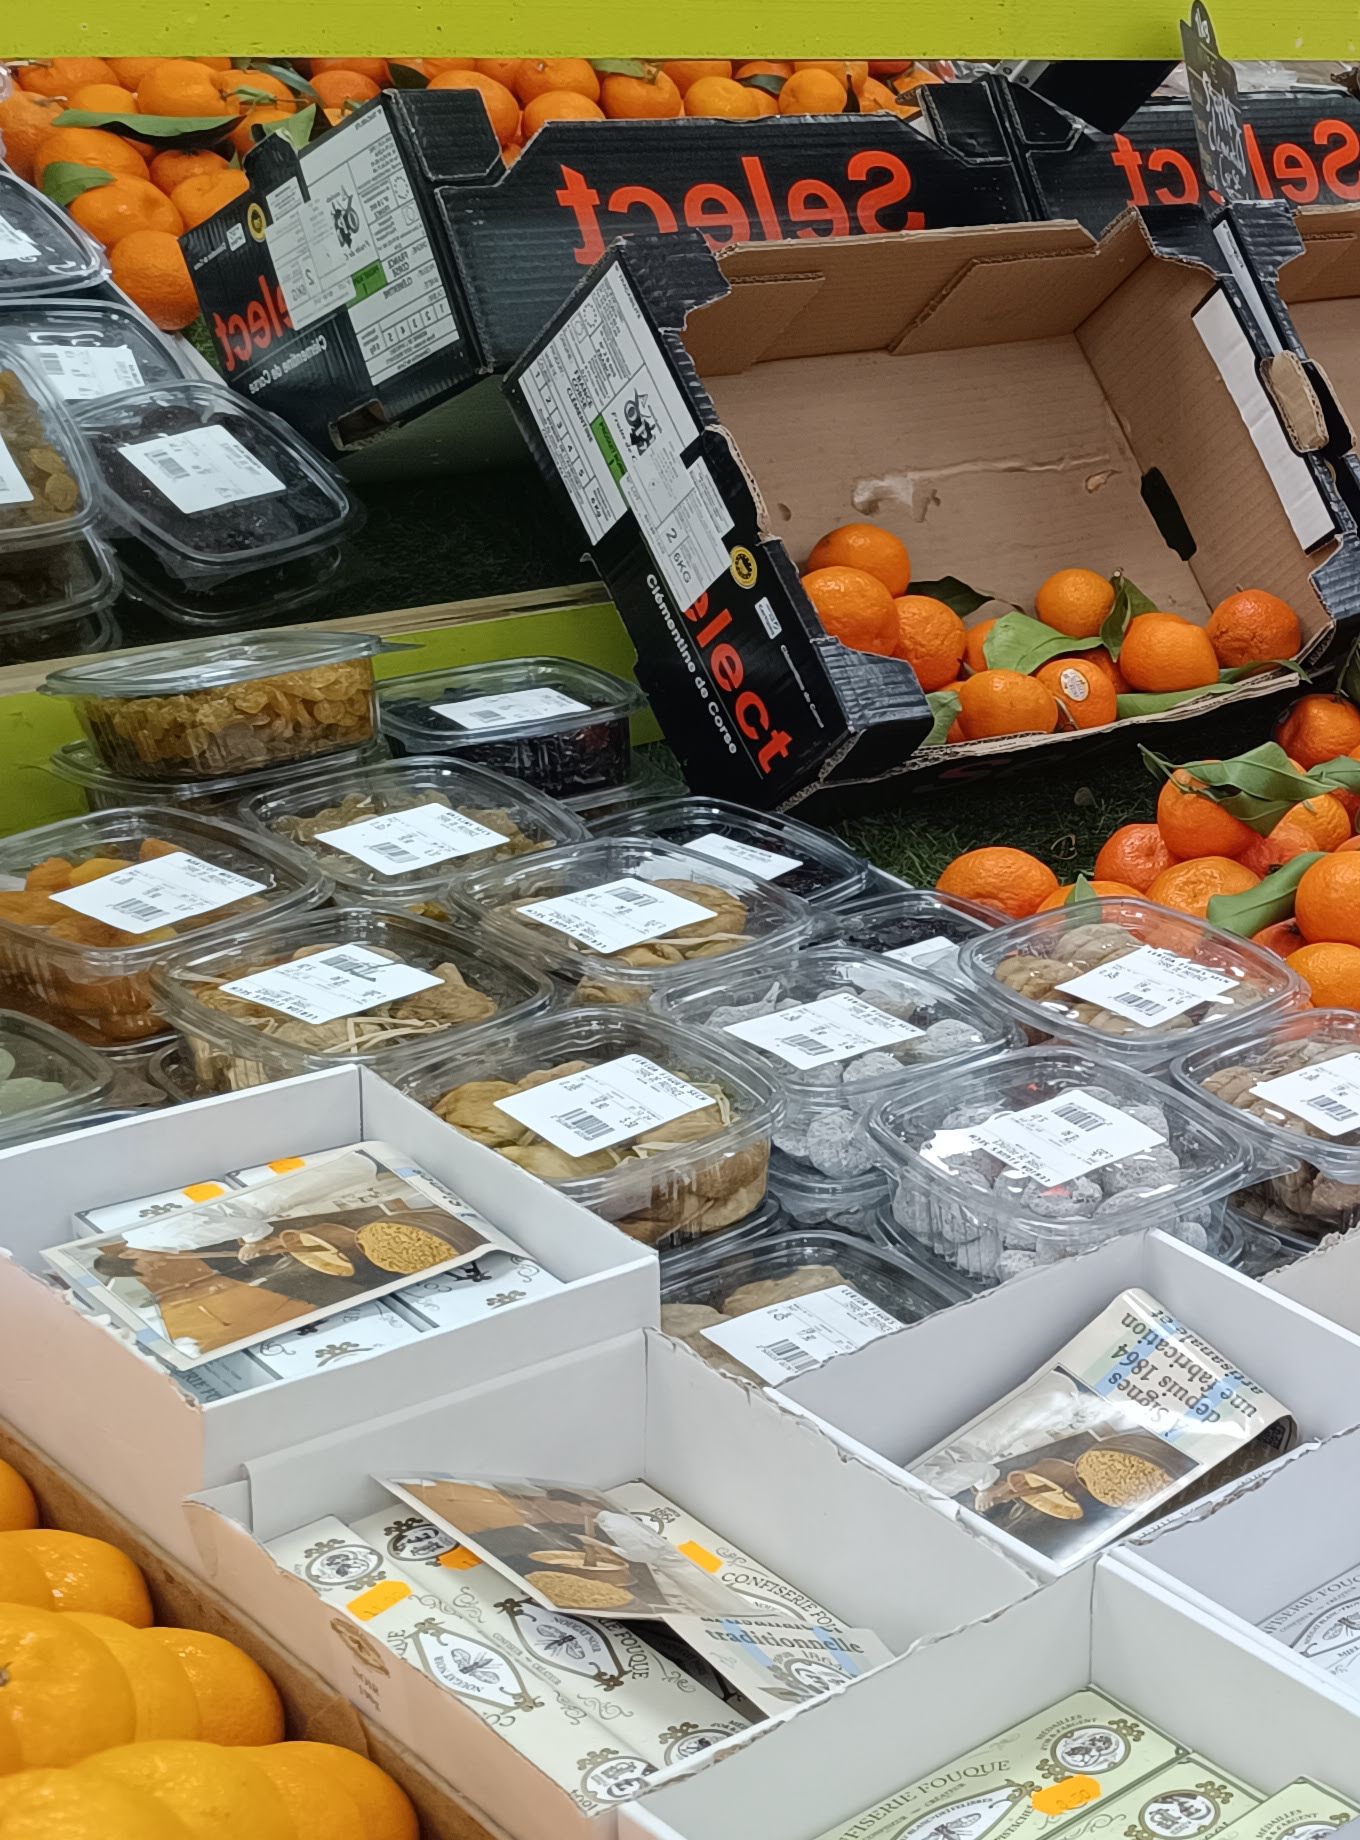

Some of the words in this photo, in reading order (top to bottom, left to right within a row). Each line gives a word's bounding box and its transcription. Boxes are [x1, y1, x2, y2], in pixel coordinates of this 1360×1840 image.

[665, 527, 678, 543] 2
[671, 552, 692, 584] 6KG
[646, 574, 696, 674] Clémentine
[695, 677, 709, 698] de
[708, 700, 737, 754] Corse
[1151, 1310, 1174, 1325] et
[1111, 1343, 1158, 1381] 1864
[1121, 1312, 1220, 1393] fabrication
[1176, 1327, 1264, 1395] artisanale
[1108, 1372, 1169, 1424] Signes
[1158, 1375, 1221, 1424] depuis
[1220, 1386, 1258, 1418] une
[721, 1571, 815, 1617] CONFISERIE
[615, 1629, 650, 1680] FOUQUE
[704, 1628, 864, 1654] traditionnelle
[1036, 1714, 1082, 1741] MÉDAILLES
[917, 1760, 1011, 1798] FOUQUE
[1255, 1808, 1302, 1839] MÉDAILLES
